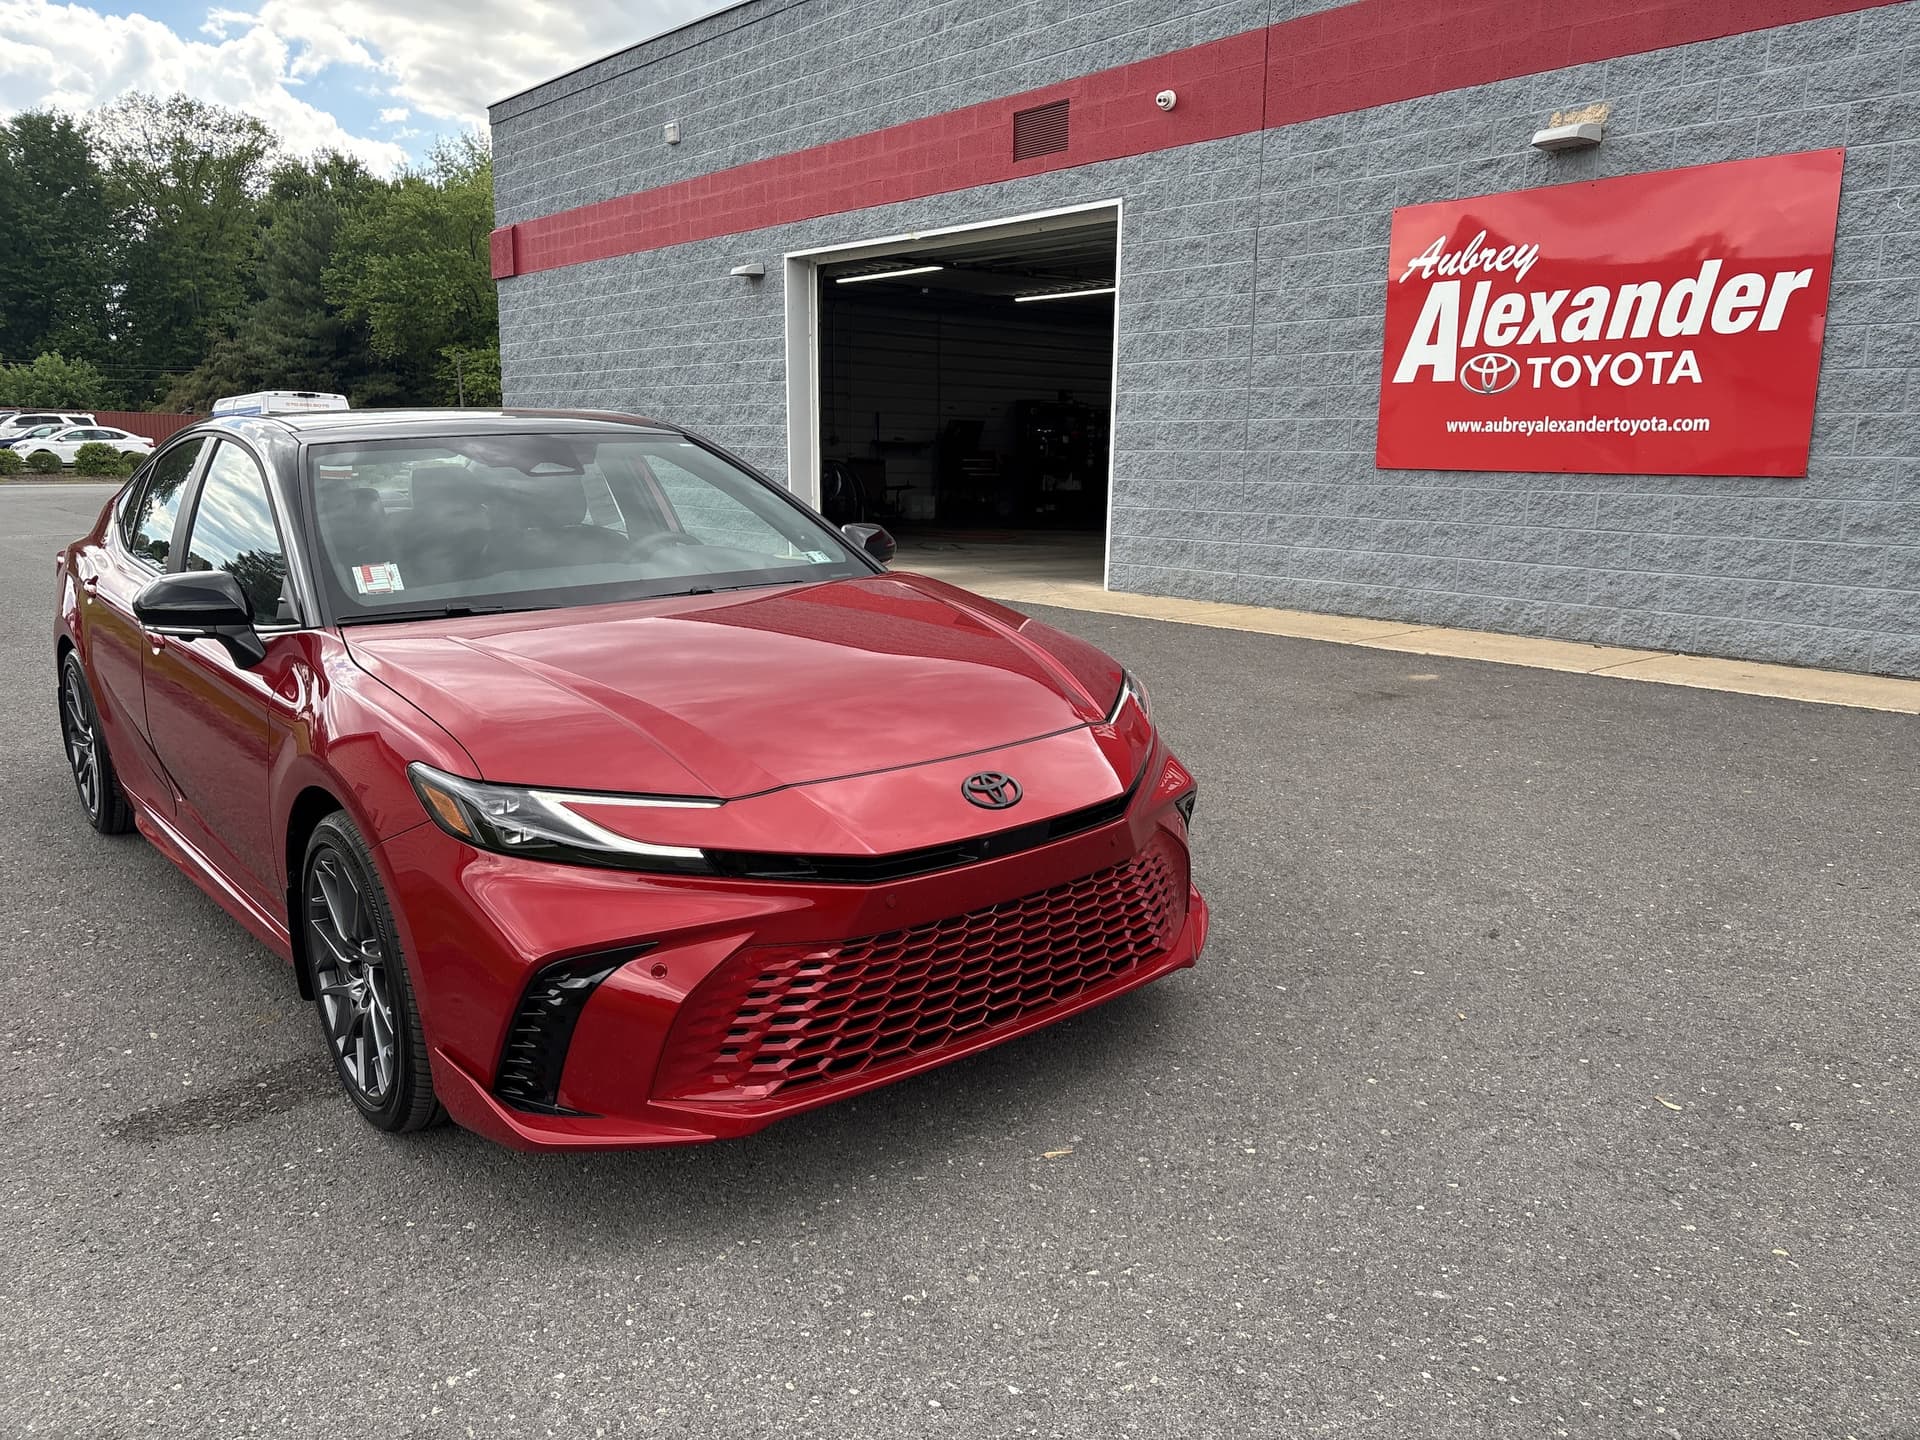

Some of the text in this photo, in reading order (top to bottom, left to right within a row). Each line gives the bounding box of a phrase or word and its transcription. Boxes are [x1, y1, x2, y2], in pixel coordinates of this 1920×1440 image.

[1399, 230, 1539, 283] Aubrey
[1392, 259, 1813, 384] Alexander
[1527, 350, 1702, 388] TOYOTA
[1446, 415, 1709, 437] www.aubreyalexandertoyota.com
